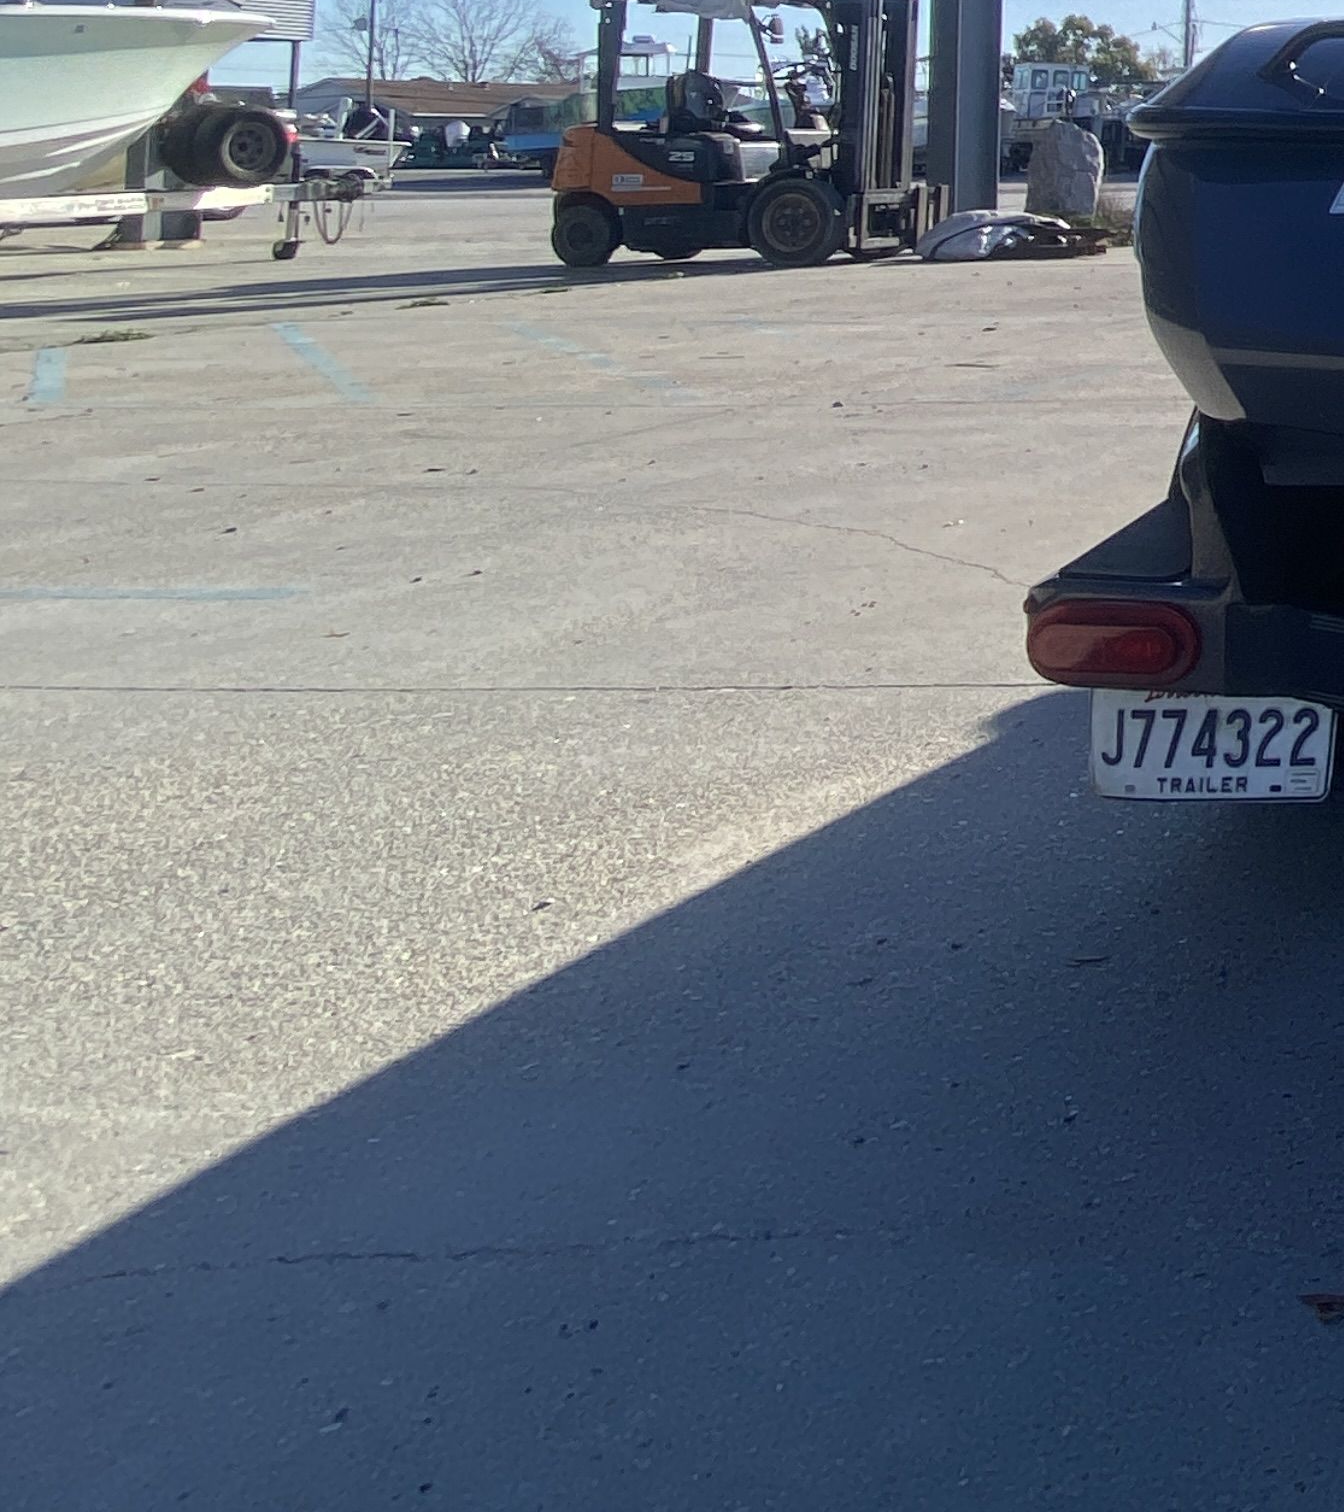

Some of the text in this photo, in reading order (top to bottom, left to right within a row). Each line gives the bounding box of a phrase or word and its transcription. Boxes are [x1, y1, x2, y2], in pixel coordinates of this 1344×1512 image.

[849, 24, 859, 71] DOOSAN
[668, 150, 695, 162] 25
[1101, 707, 1320, 769] J774322
[1156, 776, 1249, 794] TRAILER
